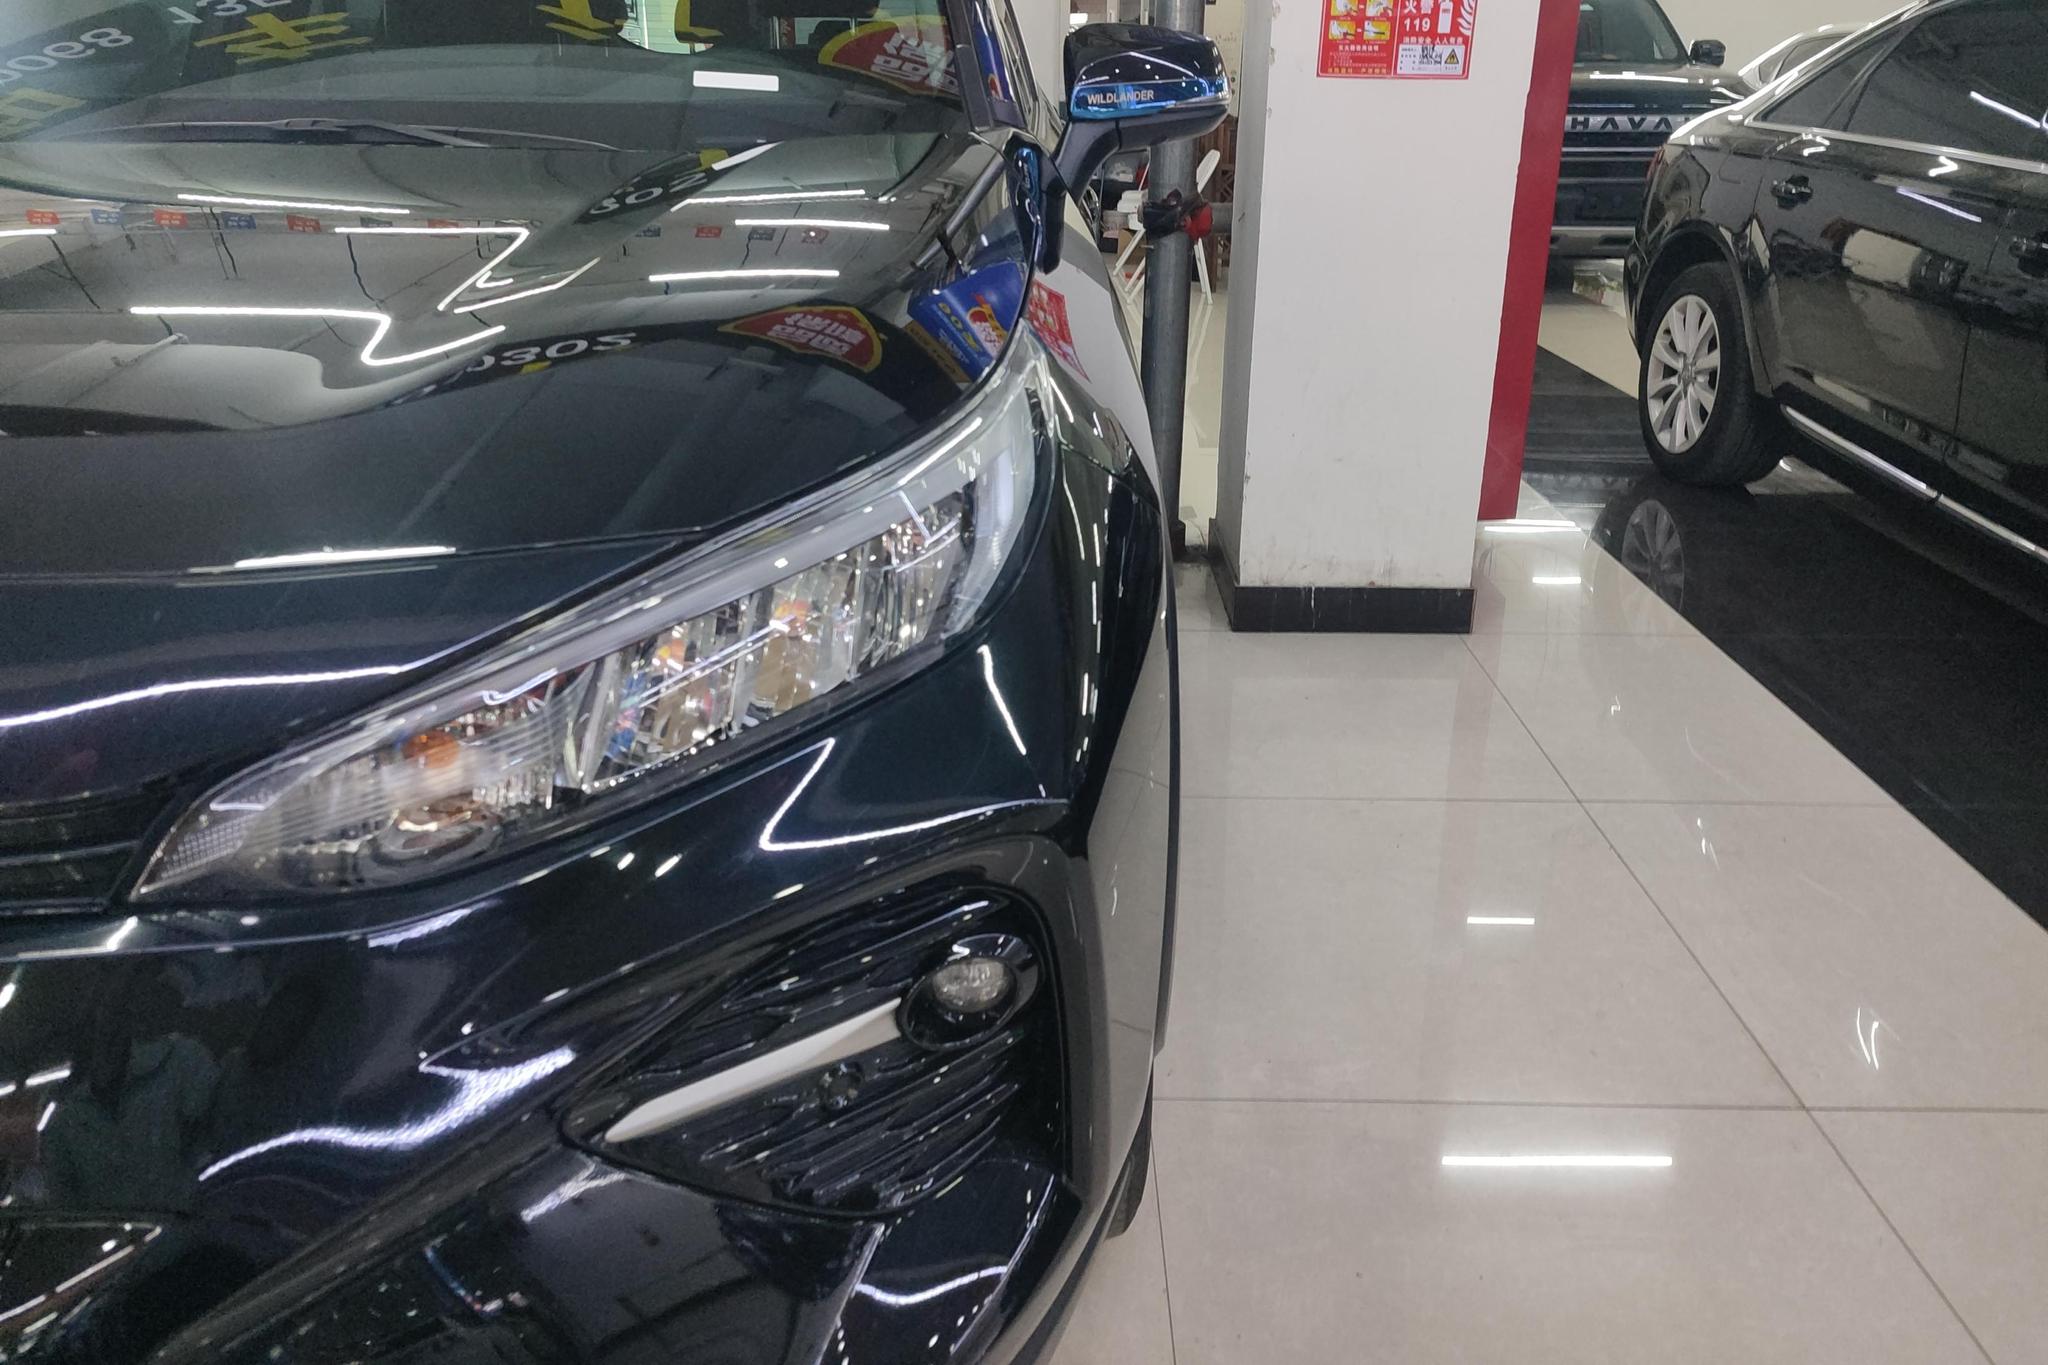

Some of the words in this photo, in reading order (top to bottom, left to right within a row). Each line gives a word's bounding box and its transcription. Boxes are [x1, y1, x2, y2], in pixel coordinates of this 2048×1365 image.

[1404, 17, 1431, 32] 119
[1087, 90, 1154, 105] WILDLANDER
[1570, 117, 1691, 131] HAVA
